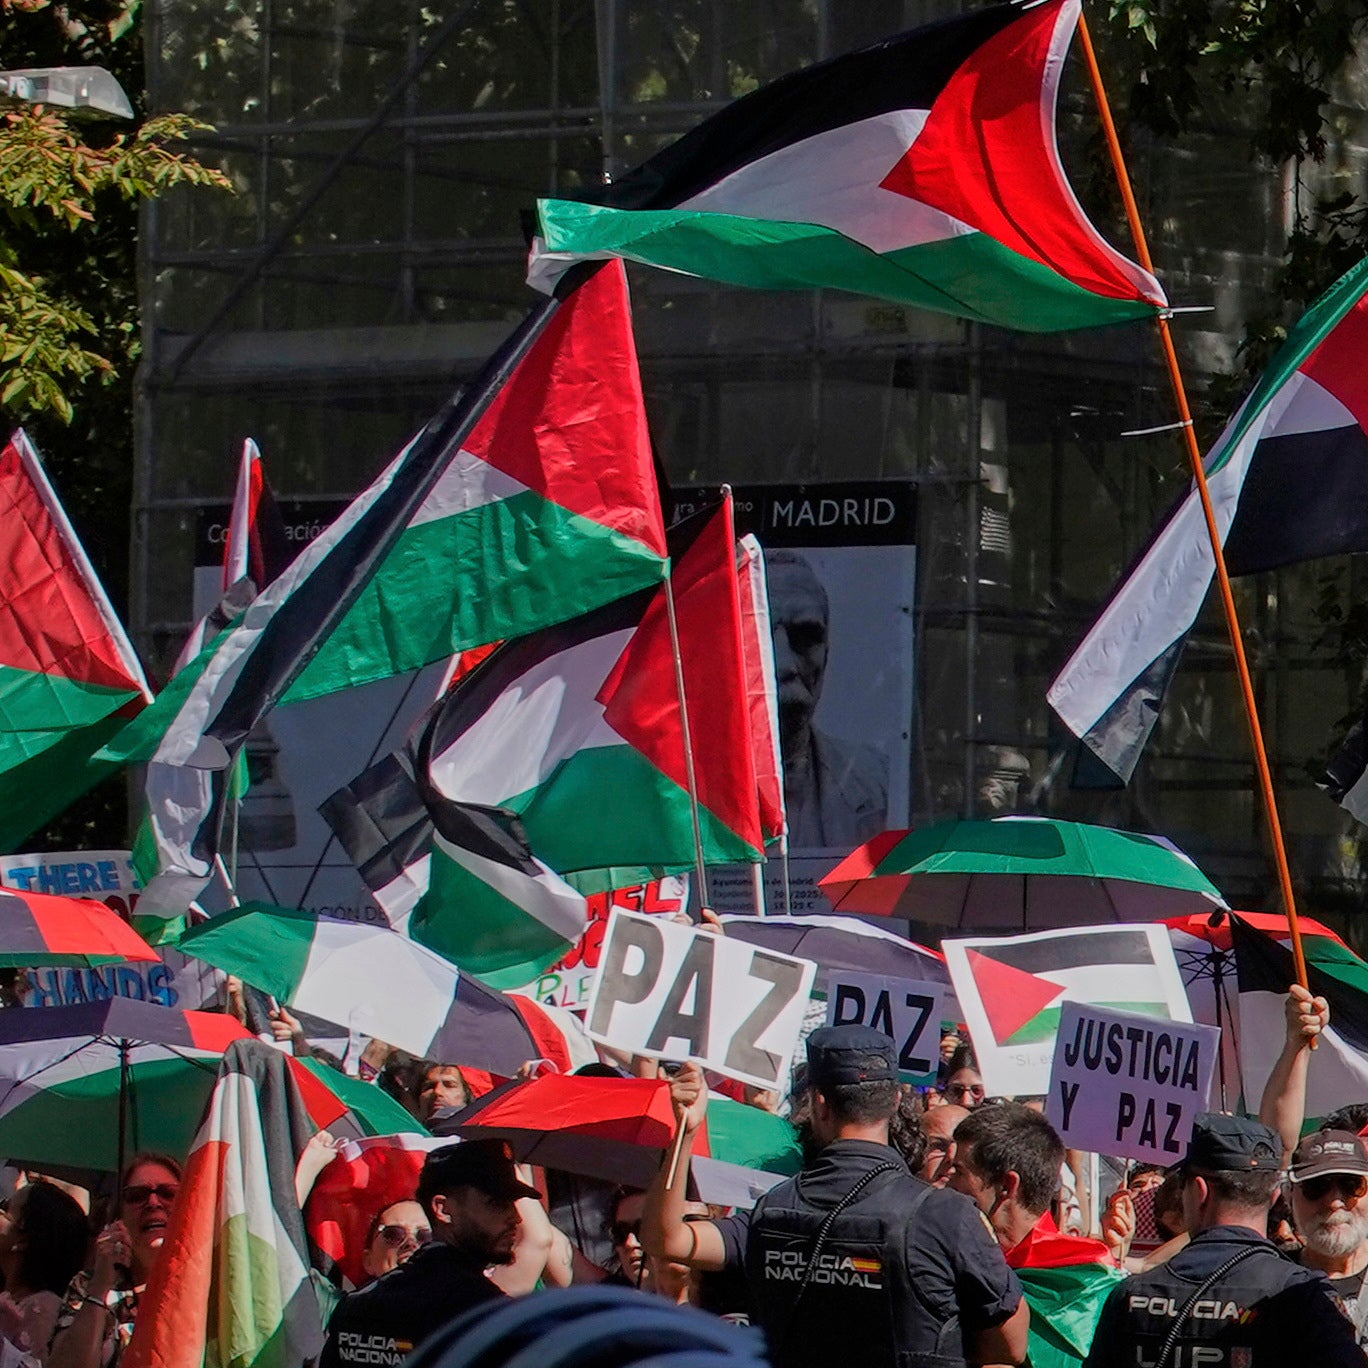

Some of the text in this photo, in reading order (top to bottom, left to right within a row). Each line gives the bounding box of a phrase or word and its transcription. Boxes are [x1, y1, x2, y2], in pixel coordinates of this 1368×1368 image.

[771, 497, 896, 528] MADRID
[8, 860, 121, 895] THERE
[24, 964, 179, 1008] HANDS
[589, 911, 806, 1084] PAZ
[833, 984, 935, 1073] PAZ
[1064, 1016, 1199, 1092] JUSTICIA
[1060, 1081, 1183, 1154] Y PAZ
[765, 1250, 855, 1272] POLCIA
[1129, 1295, 1239, 1321] POLCIA
[338, 1332, 397, 1351] POLICIA
